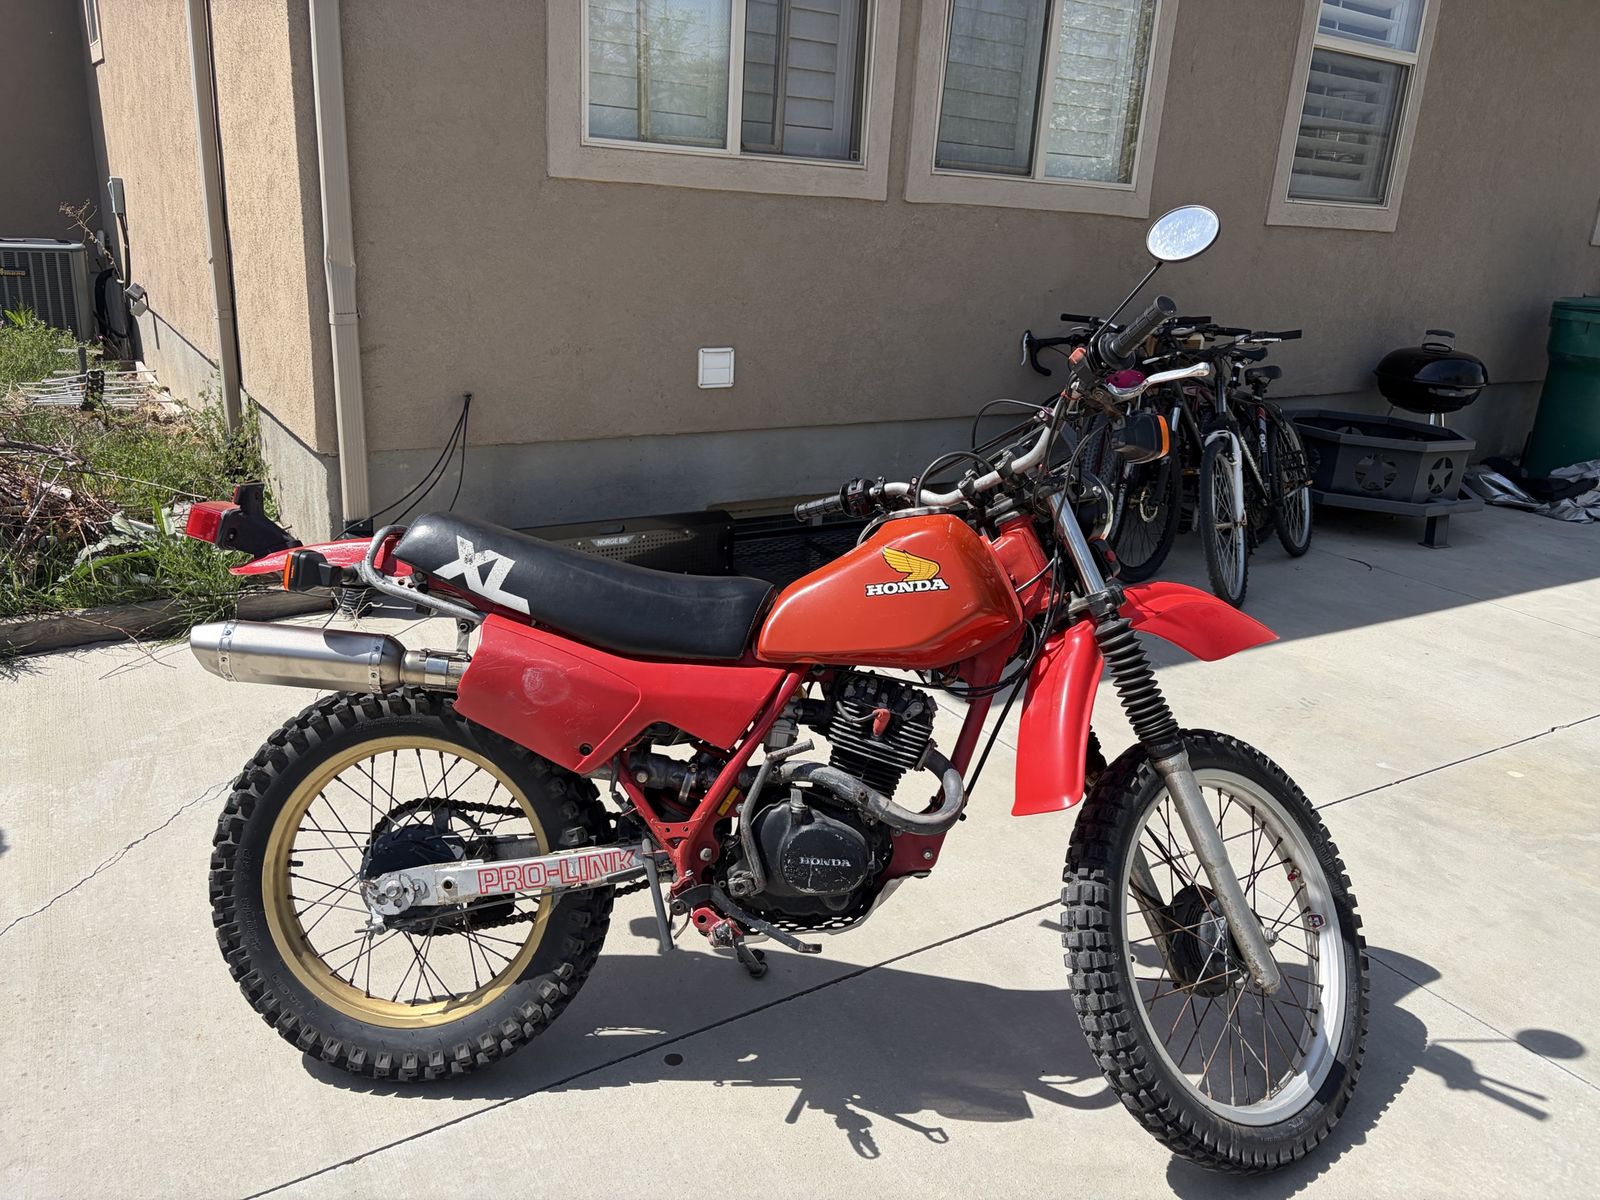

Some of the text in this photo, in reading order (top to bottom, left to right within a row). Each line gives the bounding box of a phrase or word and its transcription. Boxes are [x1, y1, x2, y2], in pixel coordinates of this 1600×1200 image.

[432, 535, 531, 615] XL
[866, 578, 949, 596] HONDA
[478, 849, 636, 895] PRO-LINK
[799, 856, 851, 867] HONDA
